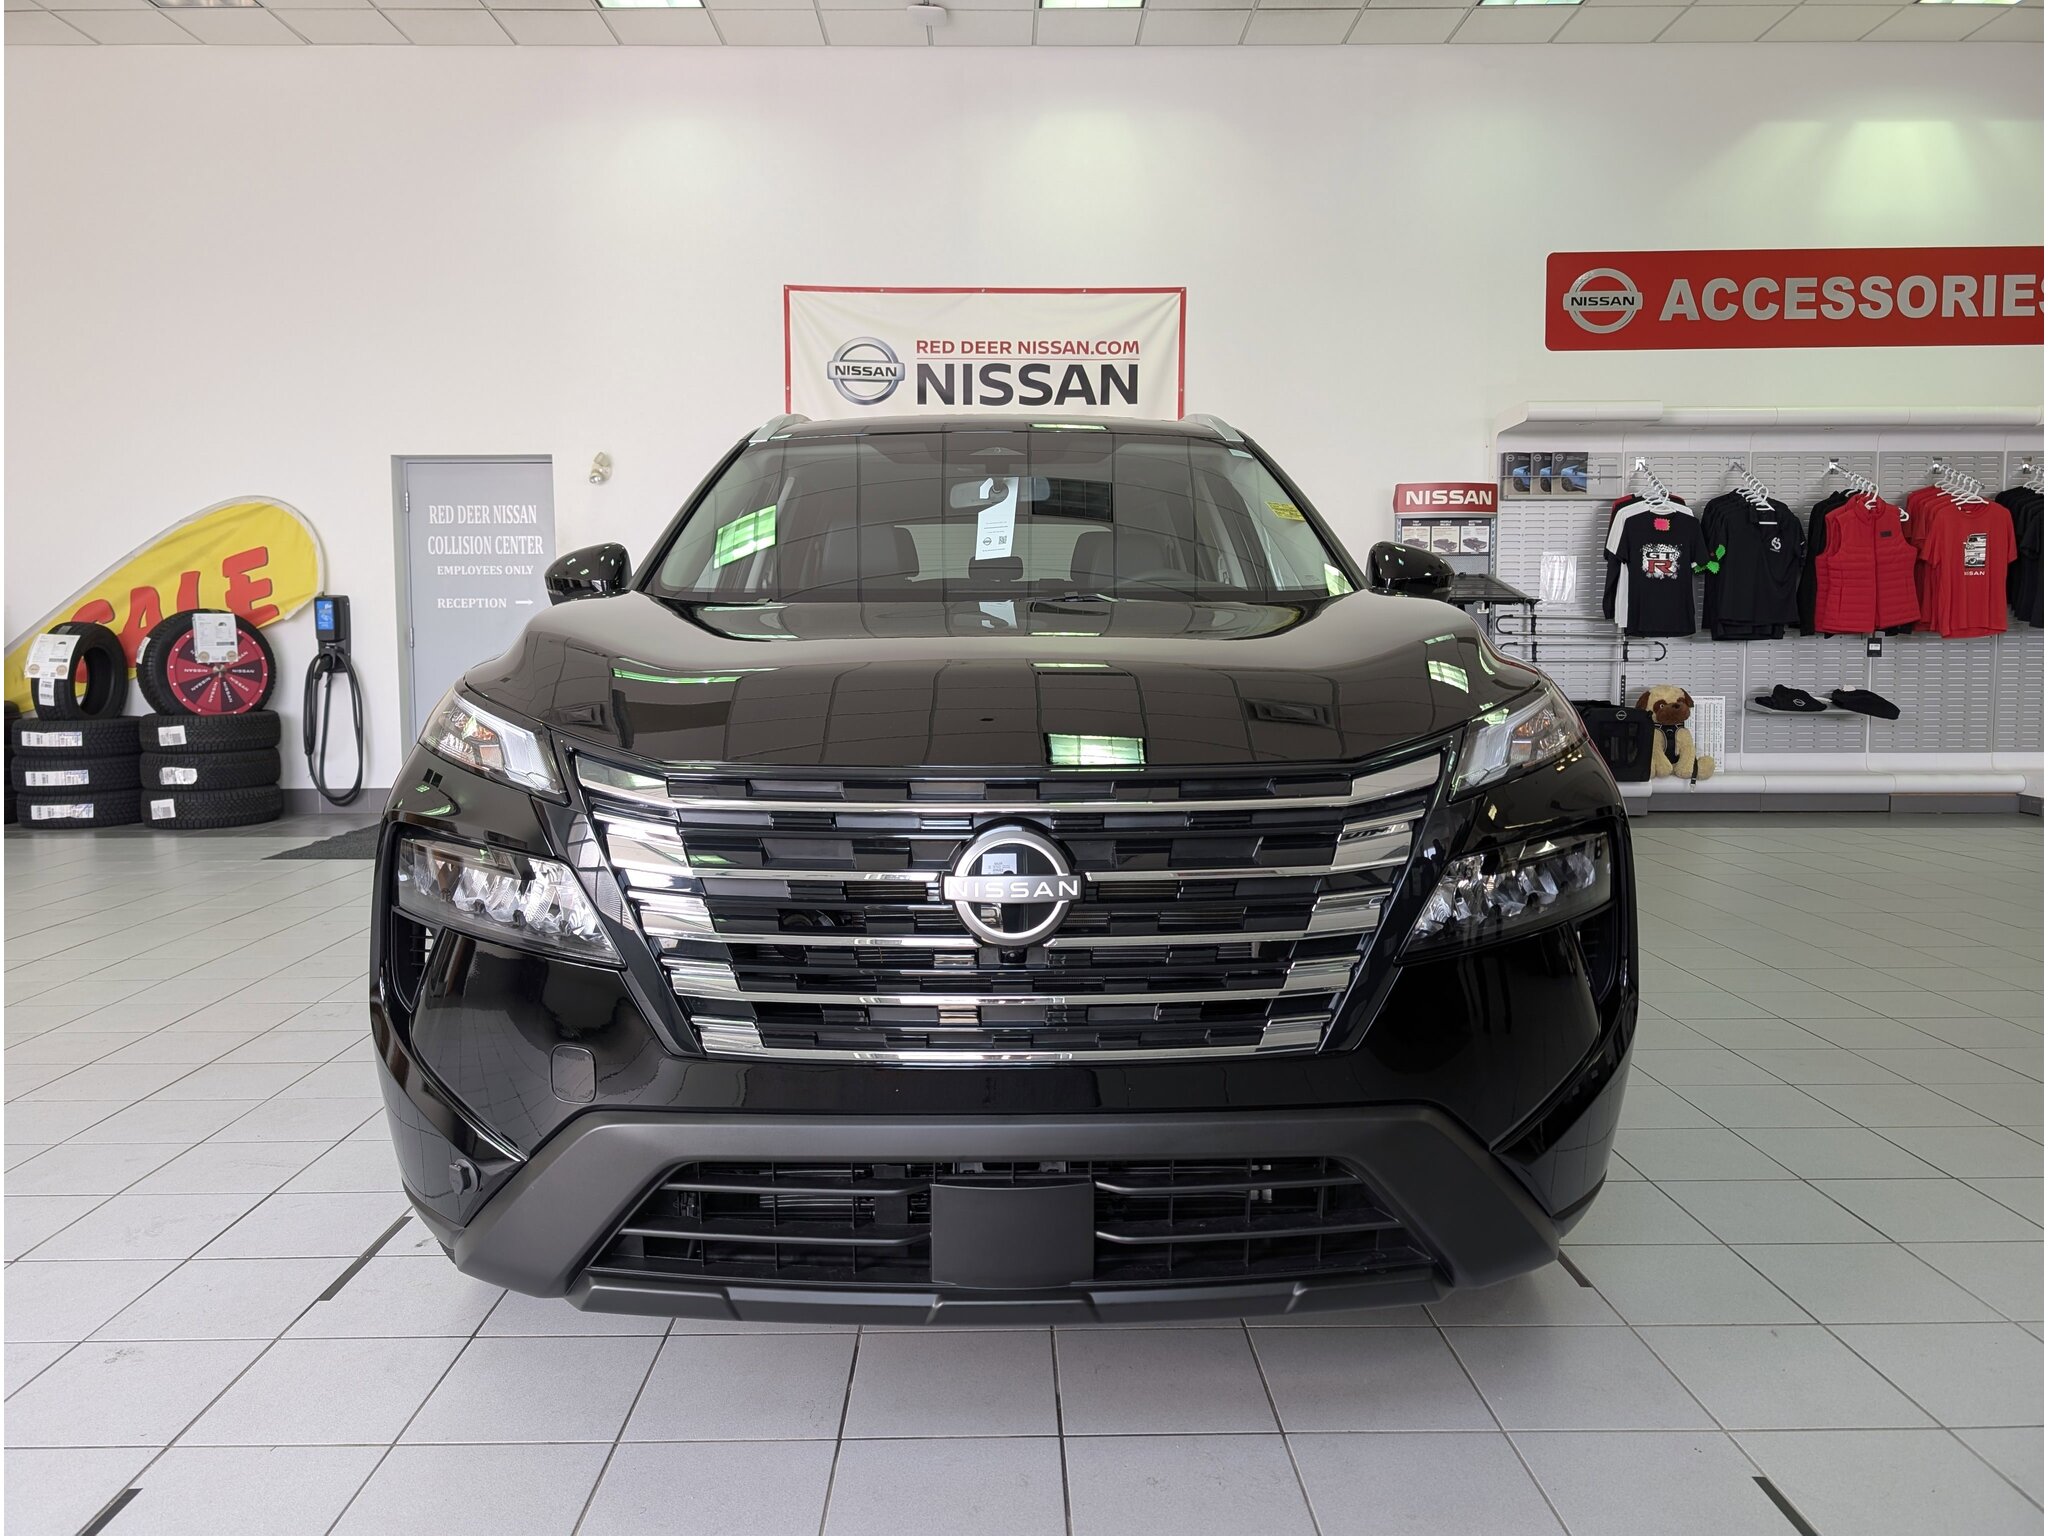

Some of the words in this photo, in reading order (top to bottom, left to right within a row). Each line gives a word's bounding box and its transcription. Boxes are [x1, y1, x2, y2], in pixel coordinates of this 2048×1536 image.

[1571, 295, 1635, 307] NISSAN
[1659, 274, 2043, 321] ACCESSORIE
[916, 339, 954, 355] RED
[960, 340, 1012, 356] DEER
[1018, 340, 1140, 356] NISSAN.COM
[834, 365, 897, 377] NISSAN
[916, 362, 1139, 406] NISSAN
[1405, 489, 1493, 506] NISSAN
[429, 505, 454, 524] RED
[457, 505, 491, 524] DEER
[493, 504, 537, 524] NISSAN
[427, 535, 492, 555] COLLISION
[495, 535, 544, 555] CENTER
[437, 565, 503, 576] EMPLOYEES
[505, 565, 534, 575] ONLY
[437, 598, 507, 609] RECEPTION
[946, 879, 1079, 899] NISSAN
